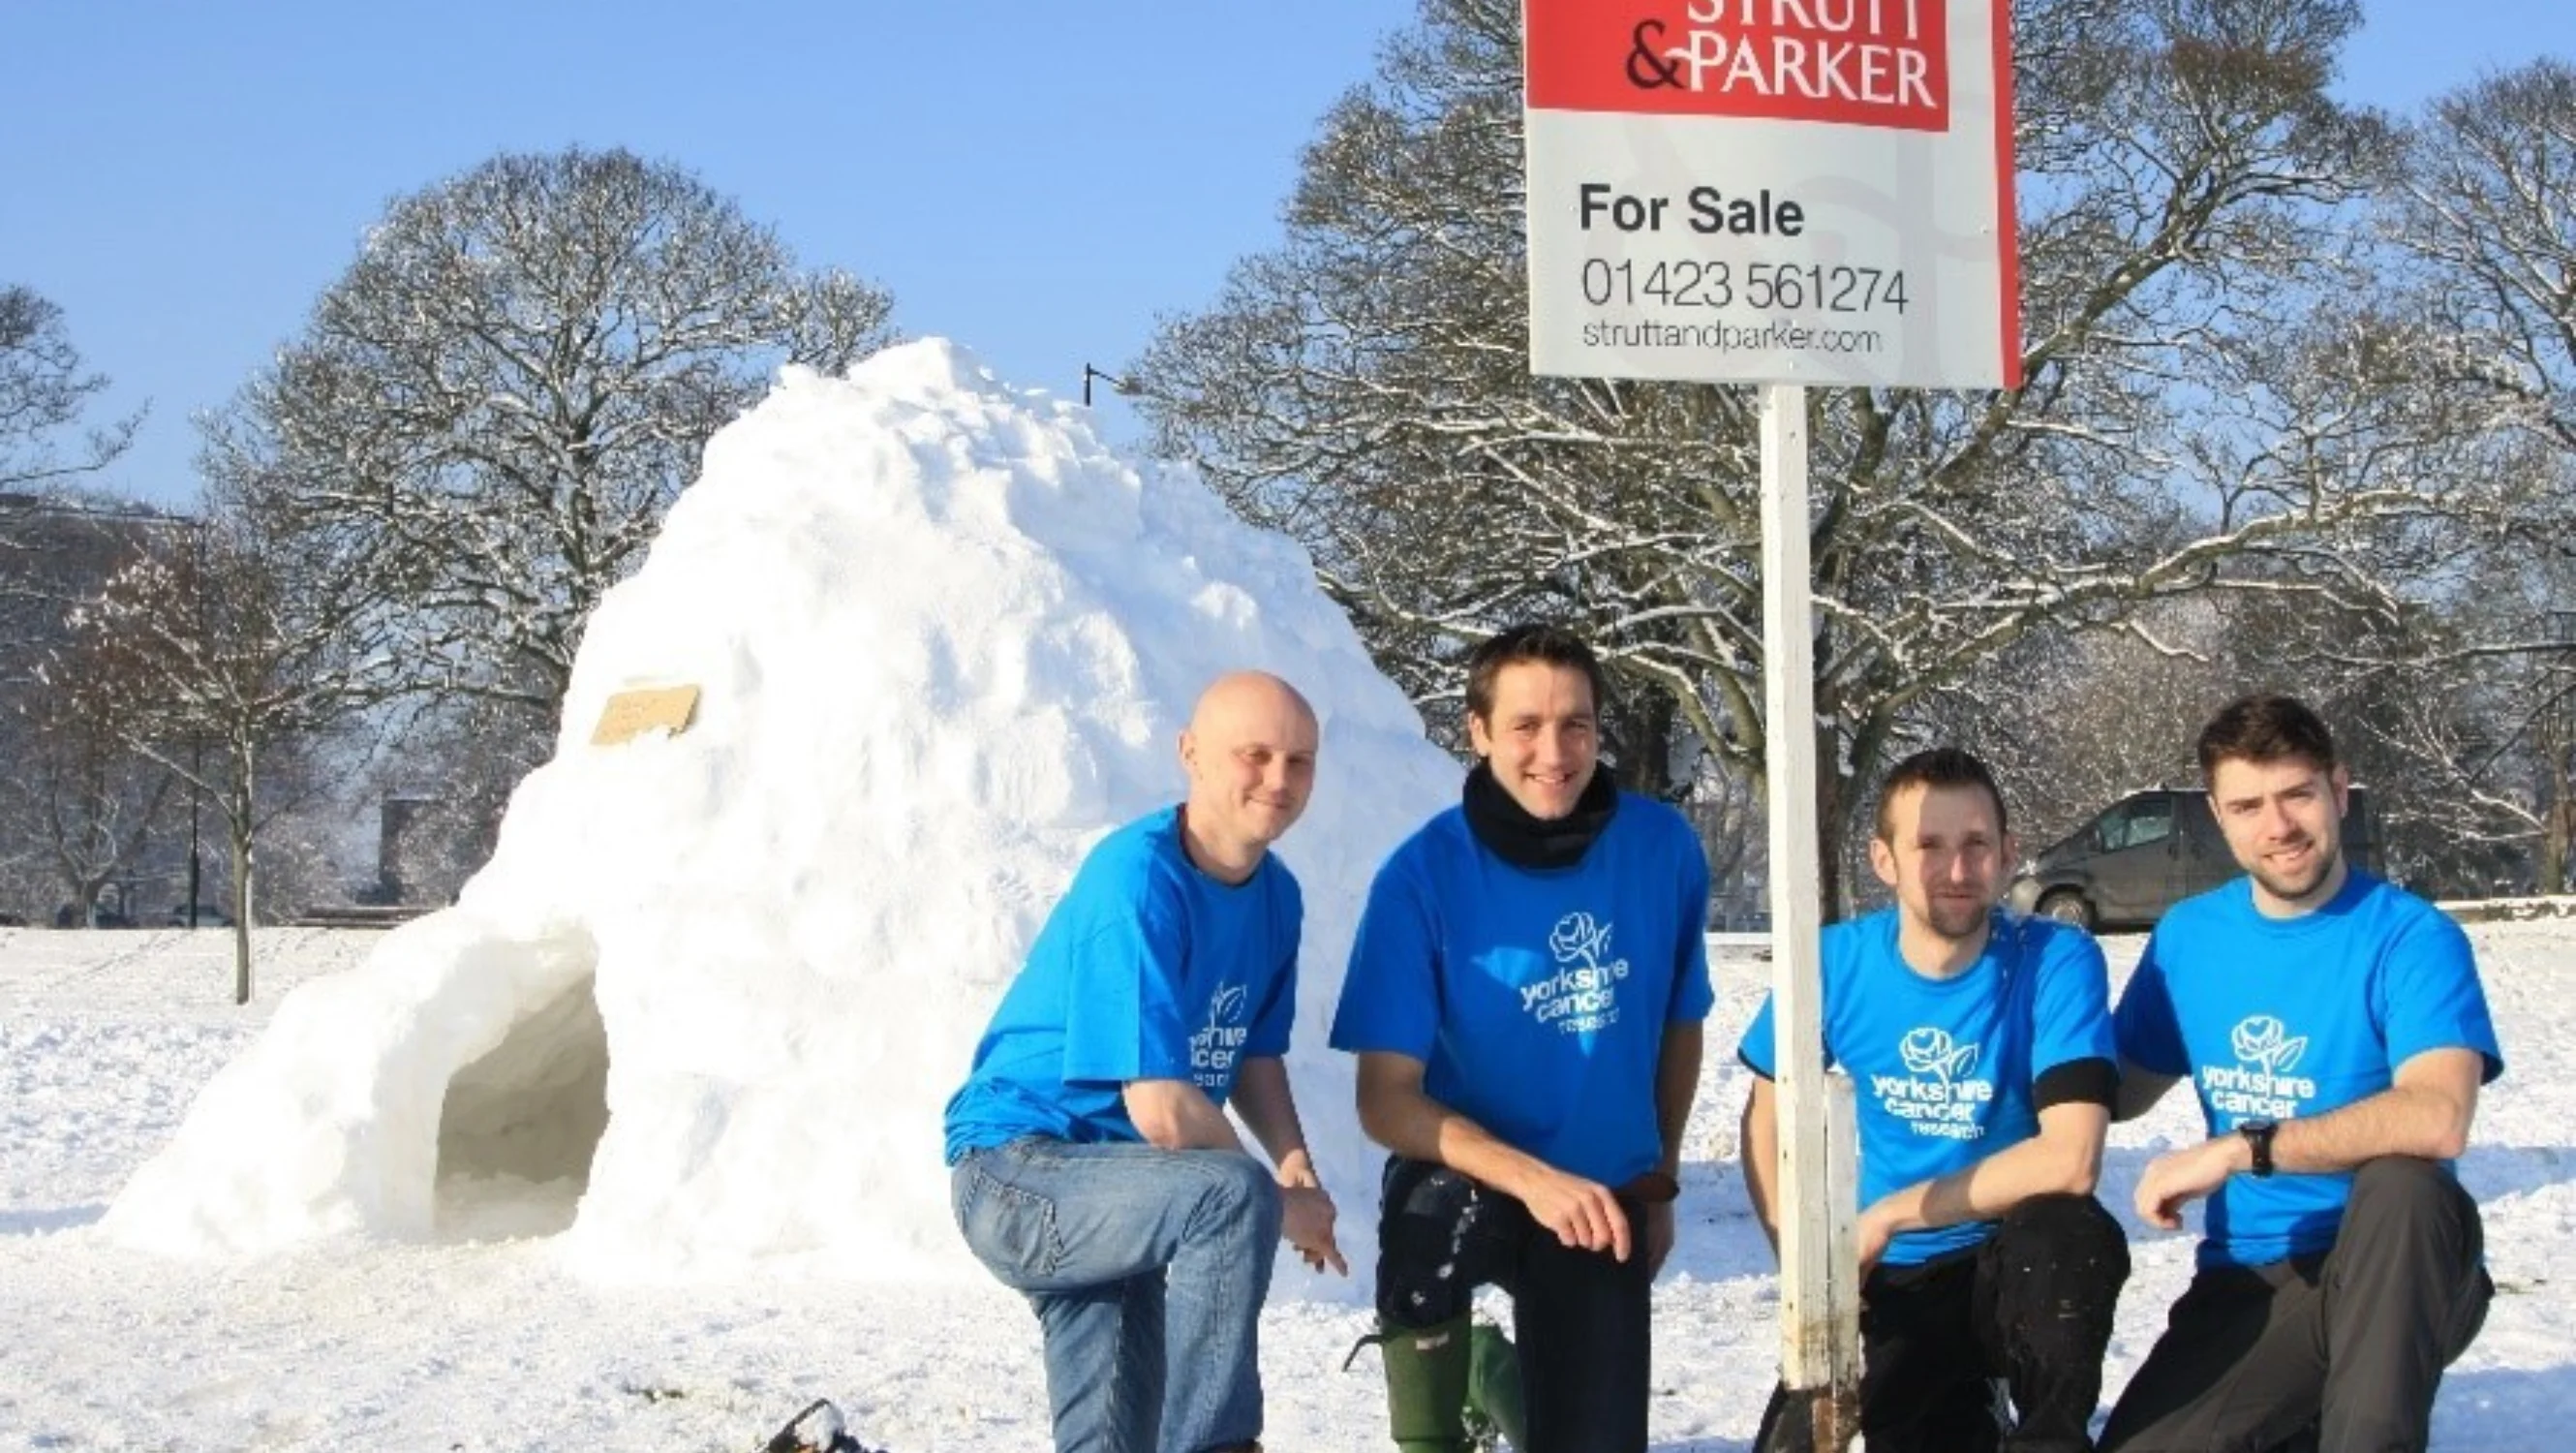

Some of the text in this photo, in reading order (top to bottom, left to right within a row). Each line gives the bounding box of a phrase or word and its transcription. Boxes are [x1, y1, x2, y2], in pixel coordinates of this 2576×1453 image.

[1663, 30, 1938, 108] PARKER
[1579, 183, 1804, 236] For Sale
[1582, 259, 1909, 314] 01423 561274
[1583, 320, 1883, 353] struttandparker.com
[1870, 1073, 1993, 1103] yorkshire
[2201, 1064, 2316, 1098] yorkshire
[1885, 1097, 1976, 1122] cancer
[2211, 1092, 2299, 1120] cancer
